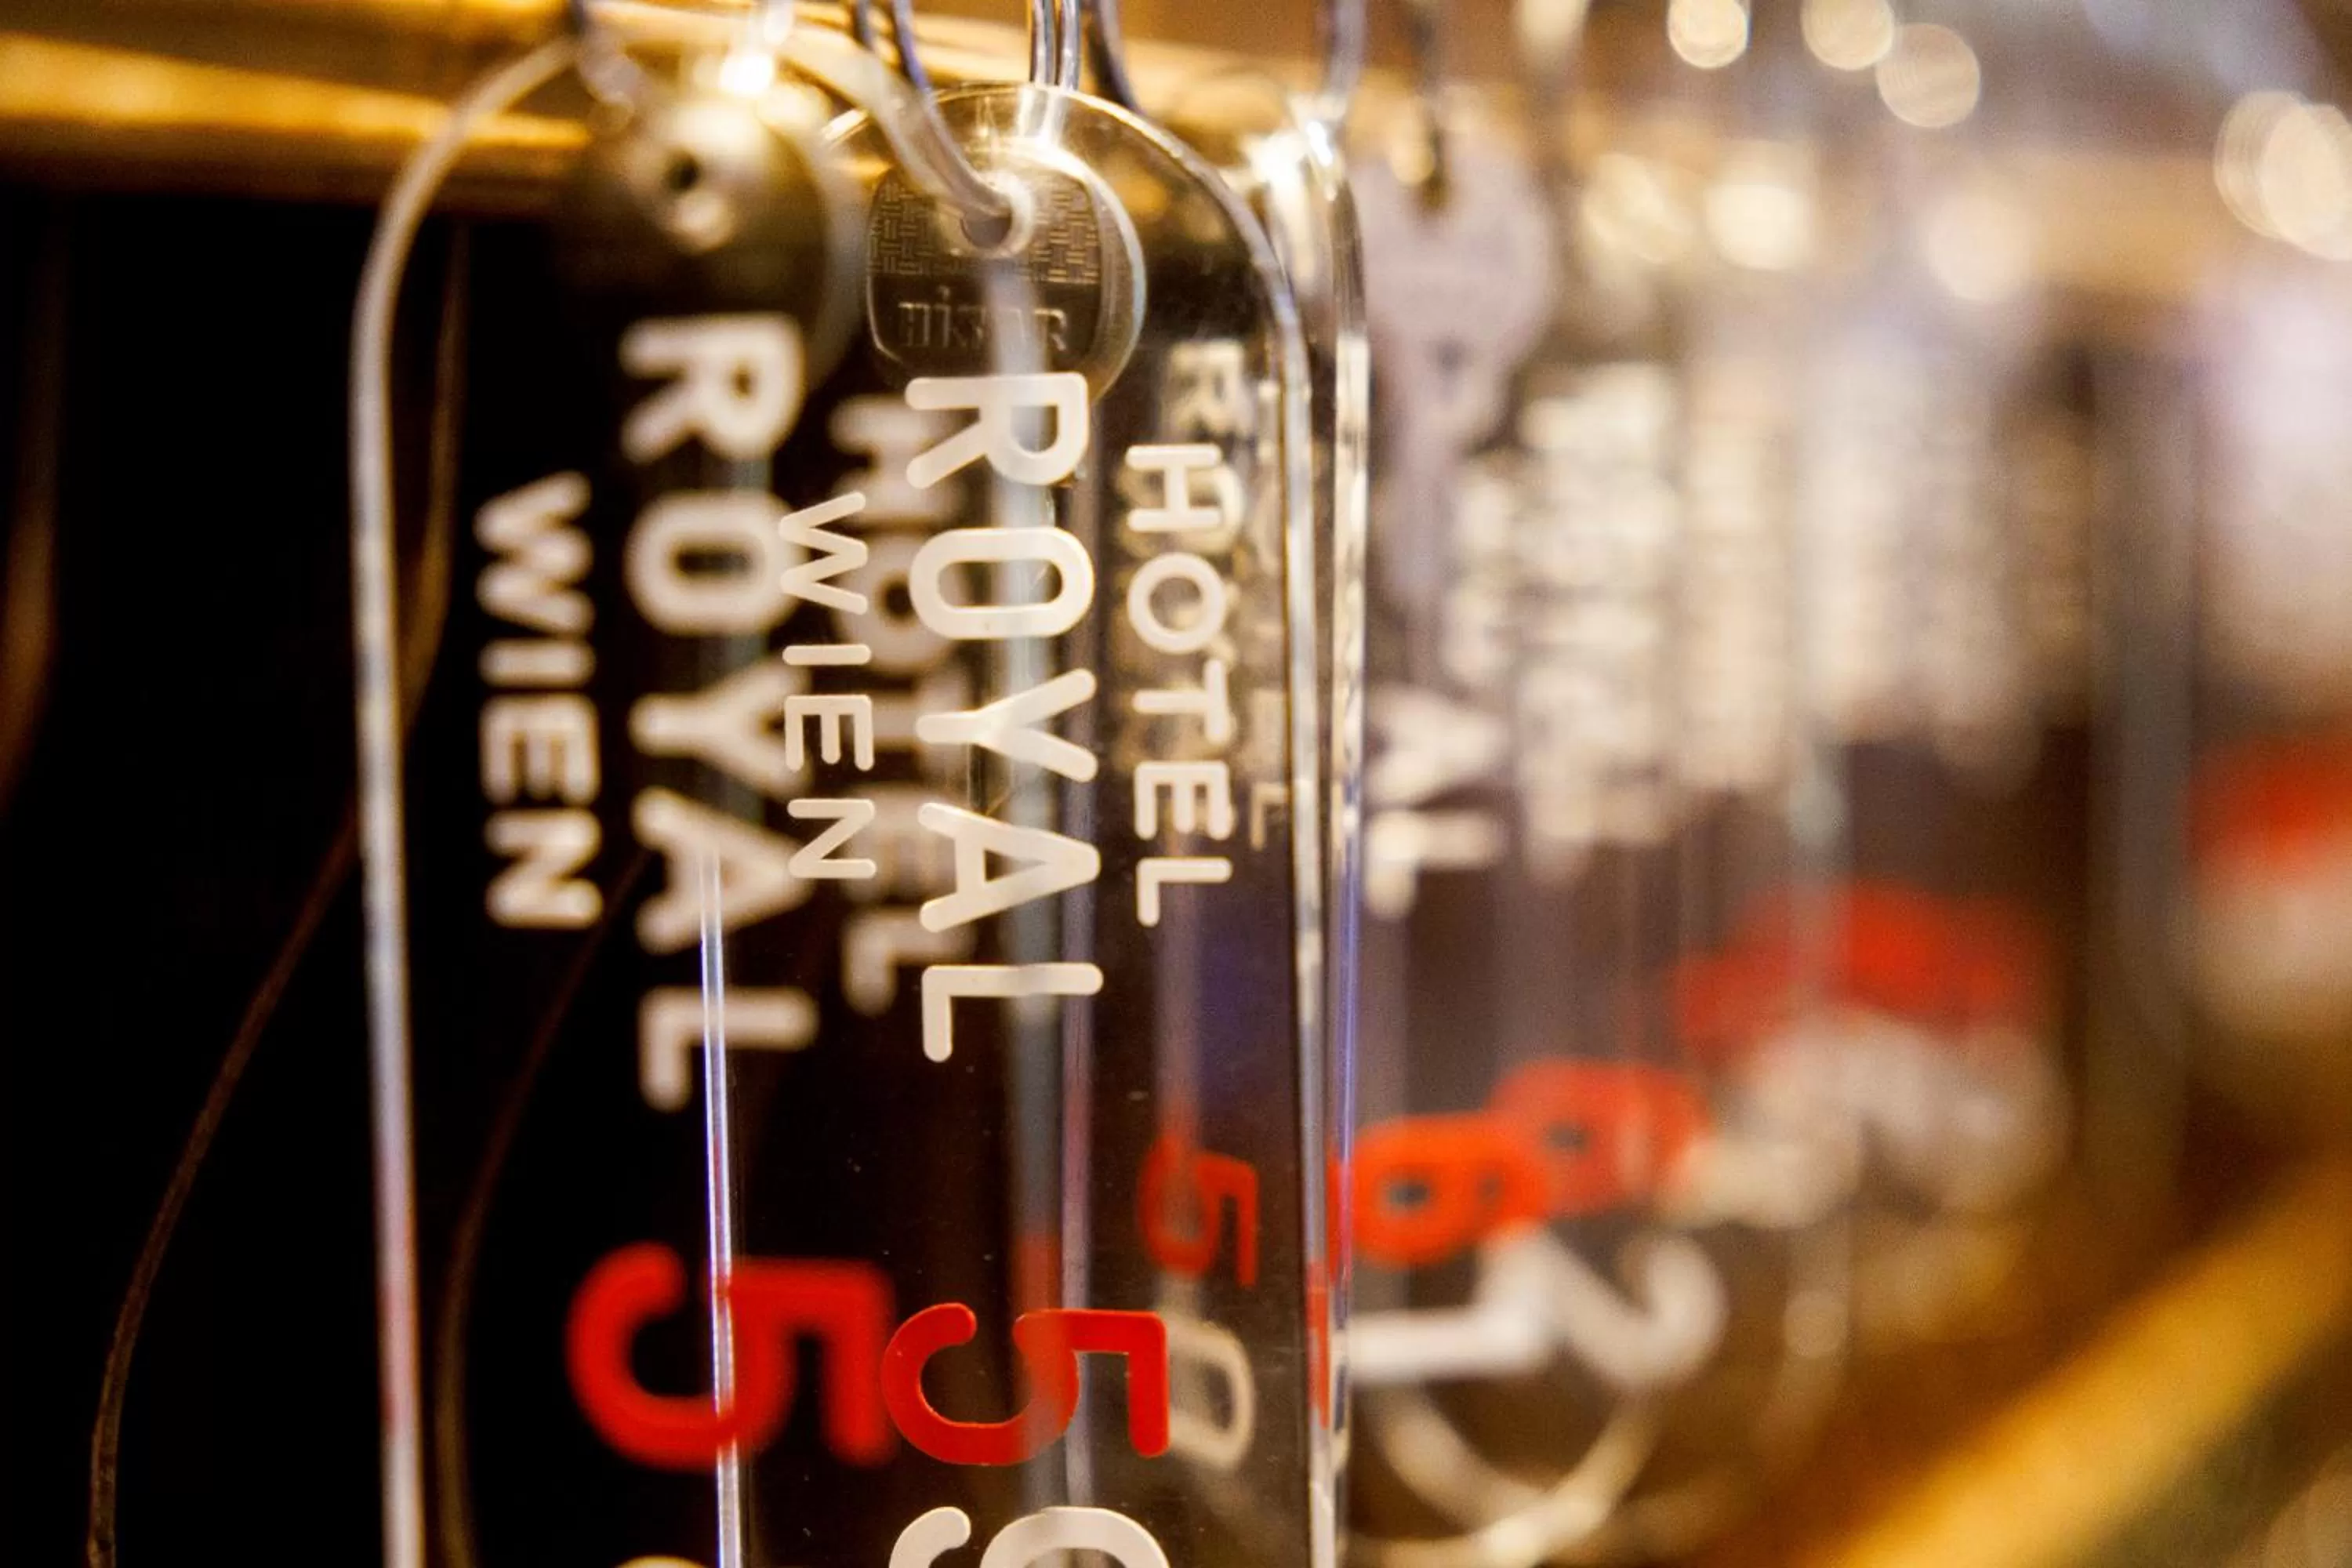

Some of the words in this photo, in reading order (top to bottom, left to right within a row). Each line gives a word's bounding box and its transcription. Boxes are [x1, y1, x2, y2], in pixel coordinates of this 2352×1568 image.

[474, 470, 605, 930] WIEN
[618, 312, 820, 1113] ROYAL
[778, 492, 877, 879] WIEN
[905, 372, 1104, 1062] ROYAL
[1125, 443, 1232, 927] HOTEL
